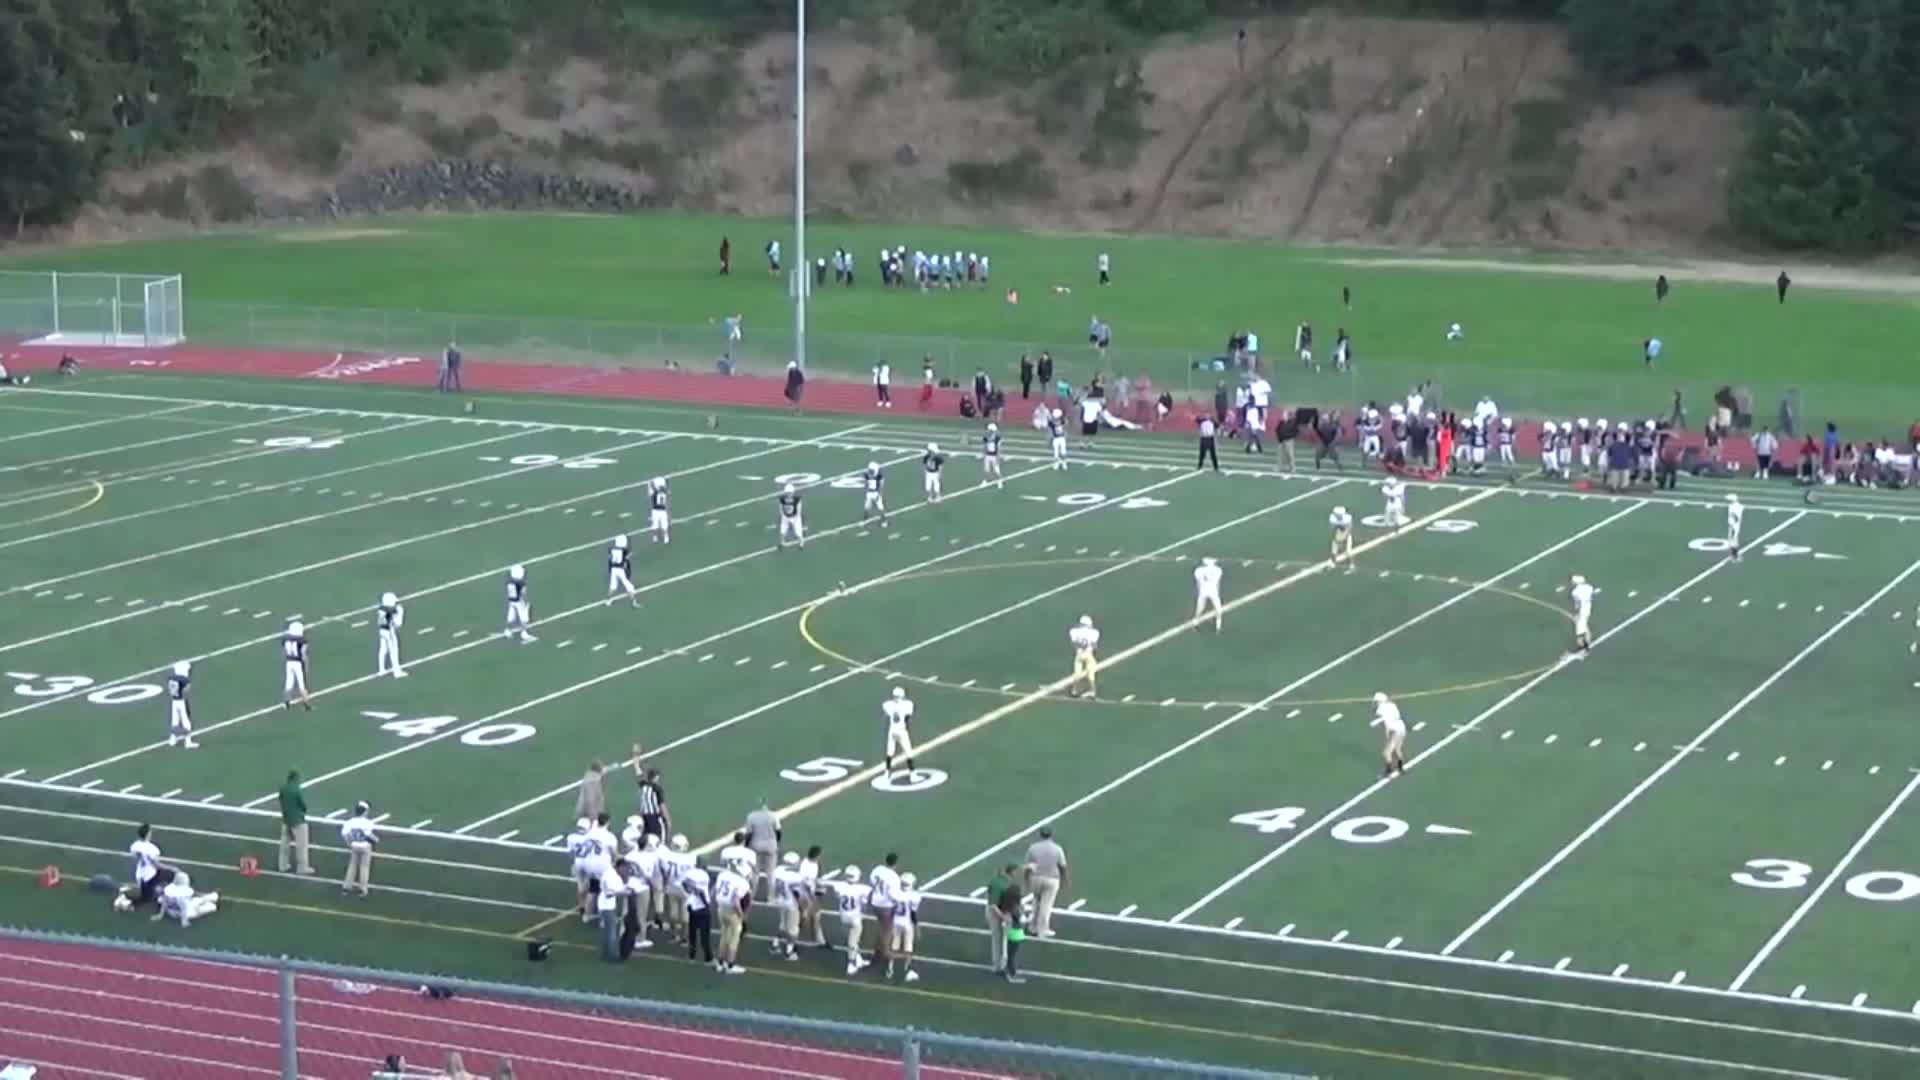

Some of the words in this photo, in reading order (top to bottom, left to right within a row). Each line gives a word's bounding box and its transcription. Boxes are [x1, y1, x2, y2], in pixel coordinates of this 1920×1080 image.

[13, 675, 164, 704] 30
[379, 715, 538, 747] 40
[779, 756, 949, 793] 50
[1228, 806, 1410, 843] 40
[1730, 858, 1920, 901] 30
